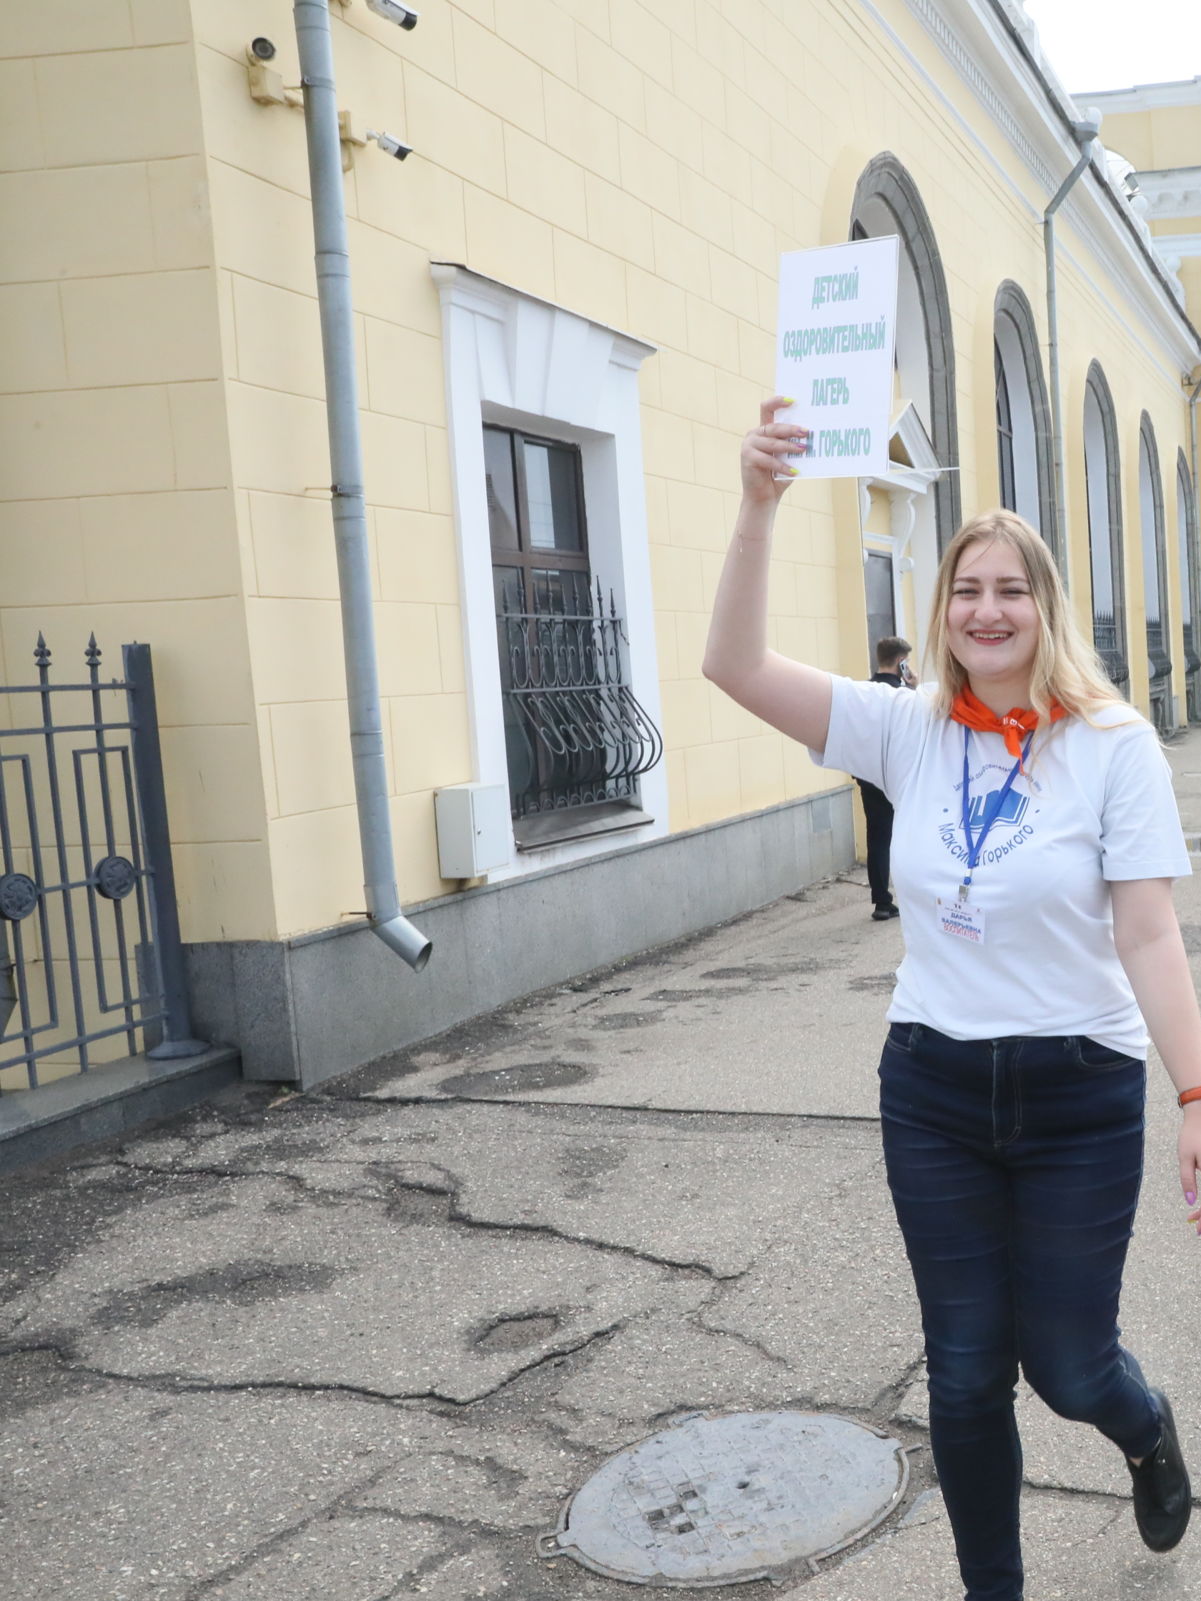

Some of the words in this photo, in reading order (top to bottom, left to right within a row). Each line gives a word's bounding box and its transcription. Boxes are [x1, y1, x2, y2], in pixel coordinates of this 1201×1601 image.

[811, 266, 859, 310] ДЕТСКИЙ
[783, 315, 886, 362] ОЗДОРОВИТЕЛЬНЫЙ
[811, 377, 849, 406] ЛАГЕРЬ
[818, 428, 871, 457] ГОРЬКОГО
[982, 824, 1035, 866] Горького
